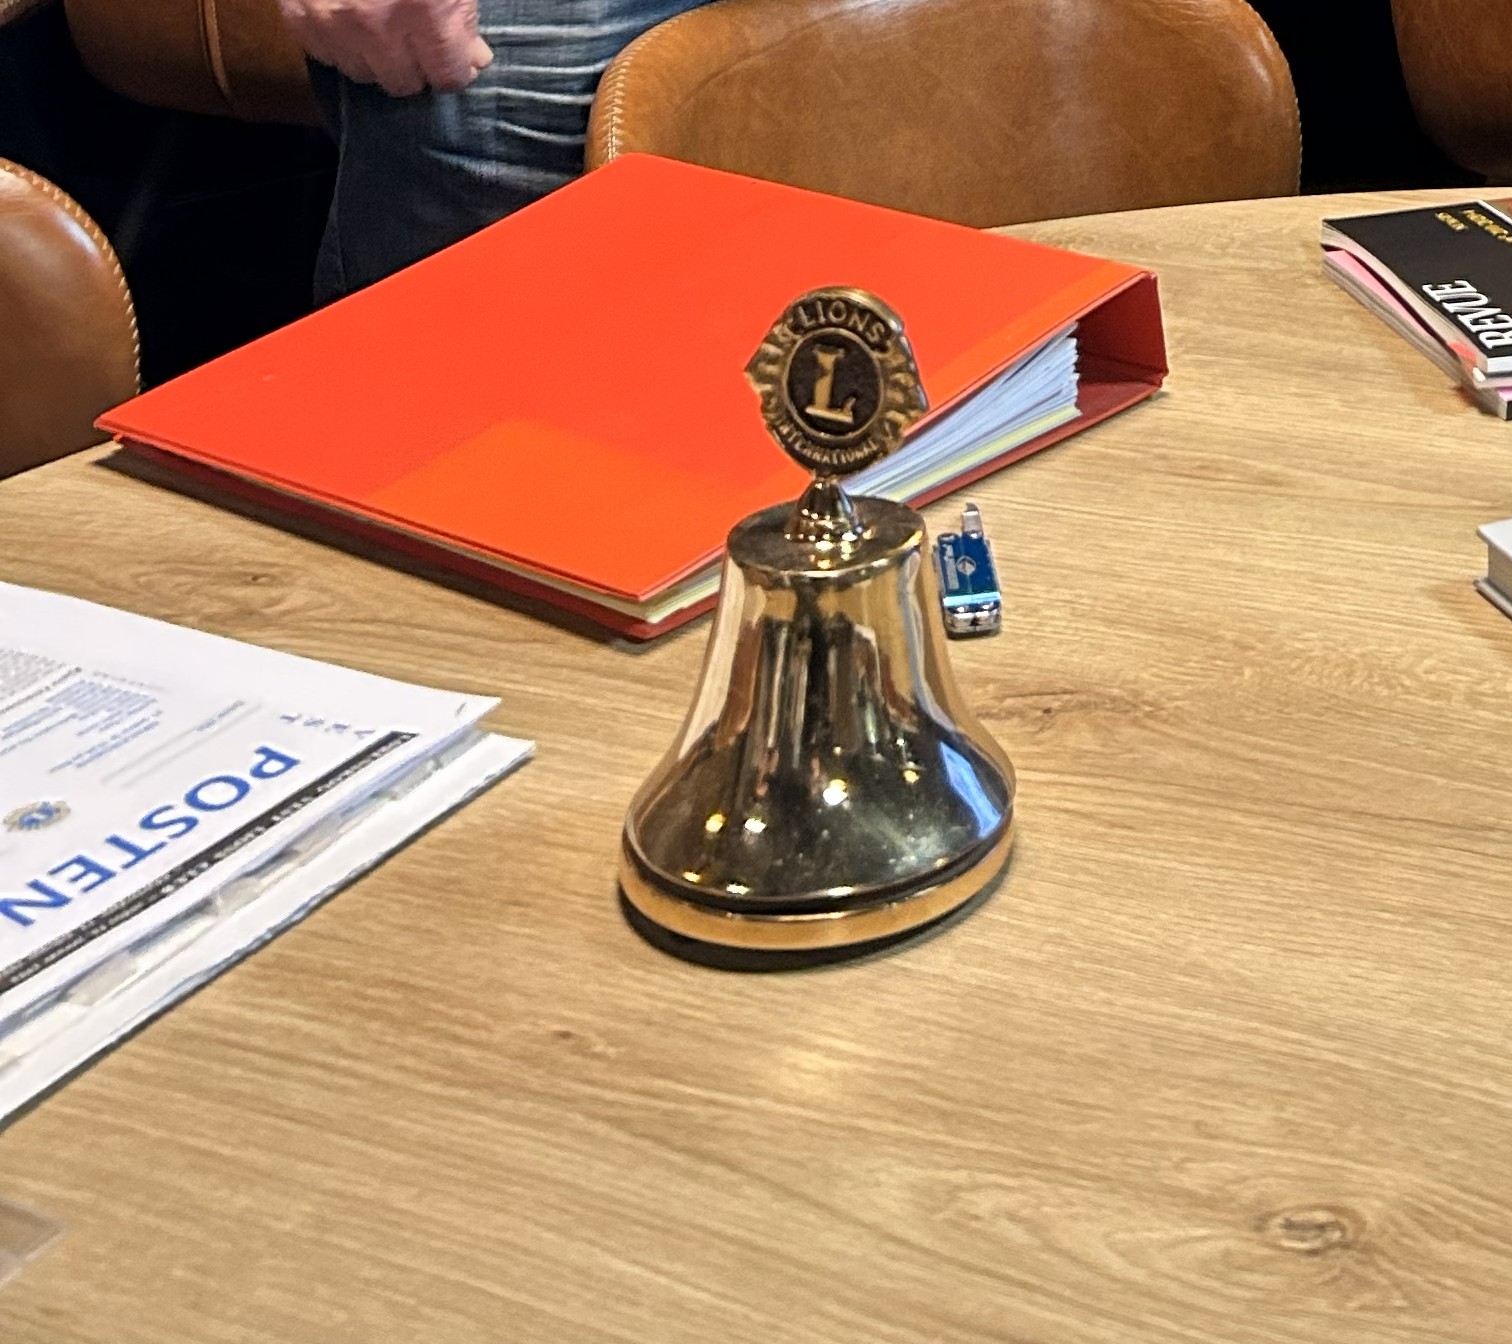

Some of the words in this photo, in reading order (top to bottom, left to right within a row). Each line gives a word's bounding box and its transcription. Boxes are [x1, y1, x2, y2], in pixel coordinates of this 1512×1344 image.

[798, 298, 885, 344] LIONS
[805, 345, 855, 424] L
[0, 744, 301, 928] POSTEN
